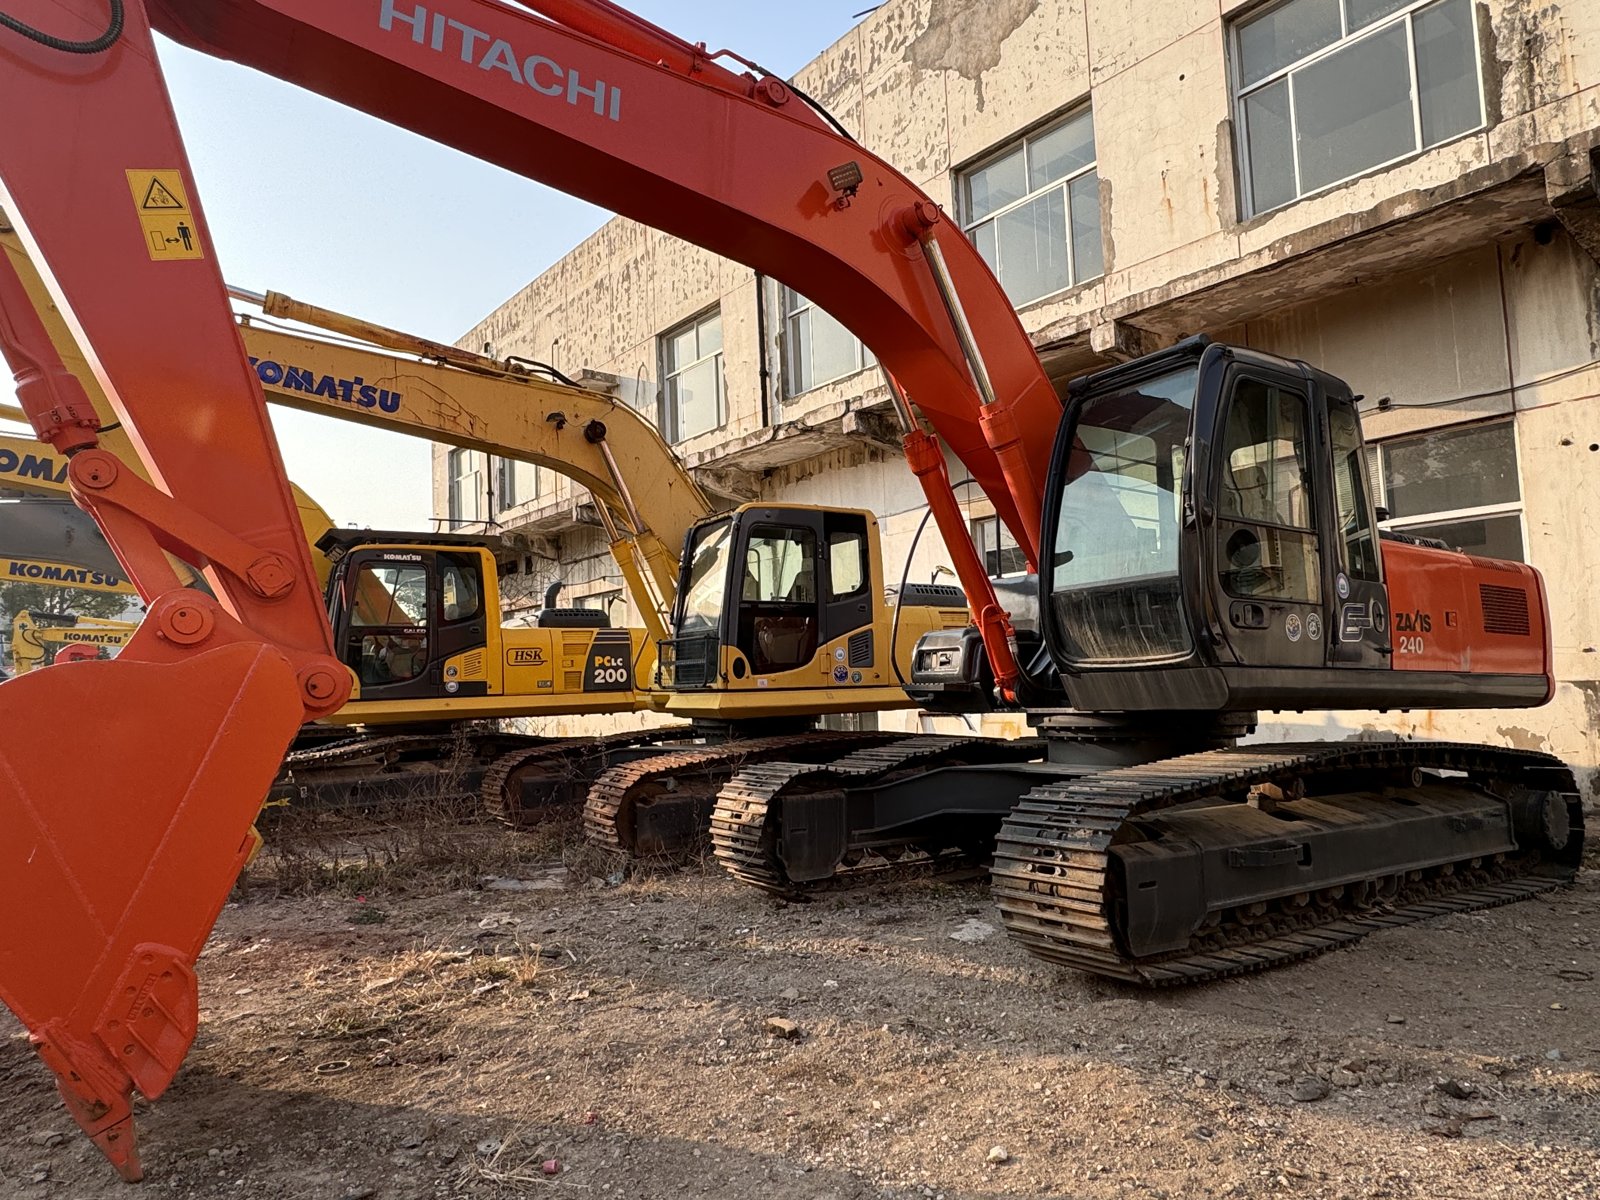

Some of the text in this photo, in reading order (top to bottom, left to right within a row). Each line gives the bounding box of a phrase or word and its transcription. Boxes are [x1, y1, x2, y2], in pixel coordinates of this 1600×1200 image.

[379, 0, 621, 122] HITACHI
[249, 356, 401, 413] OMATSU
[383, 553, 422, 561] KOMATSU
[9, 562, 119, 586] KOMATSU
[64, 632, 122, 644] KOMATSU
[1399, 636, 1424, 654] 240
[514, 650, 543, 661] HSK
[594, 668, 628, 684] 200
